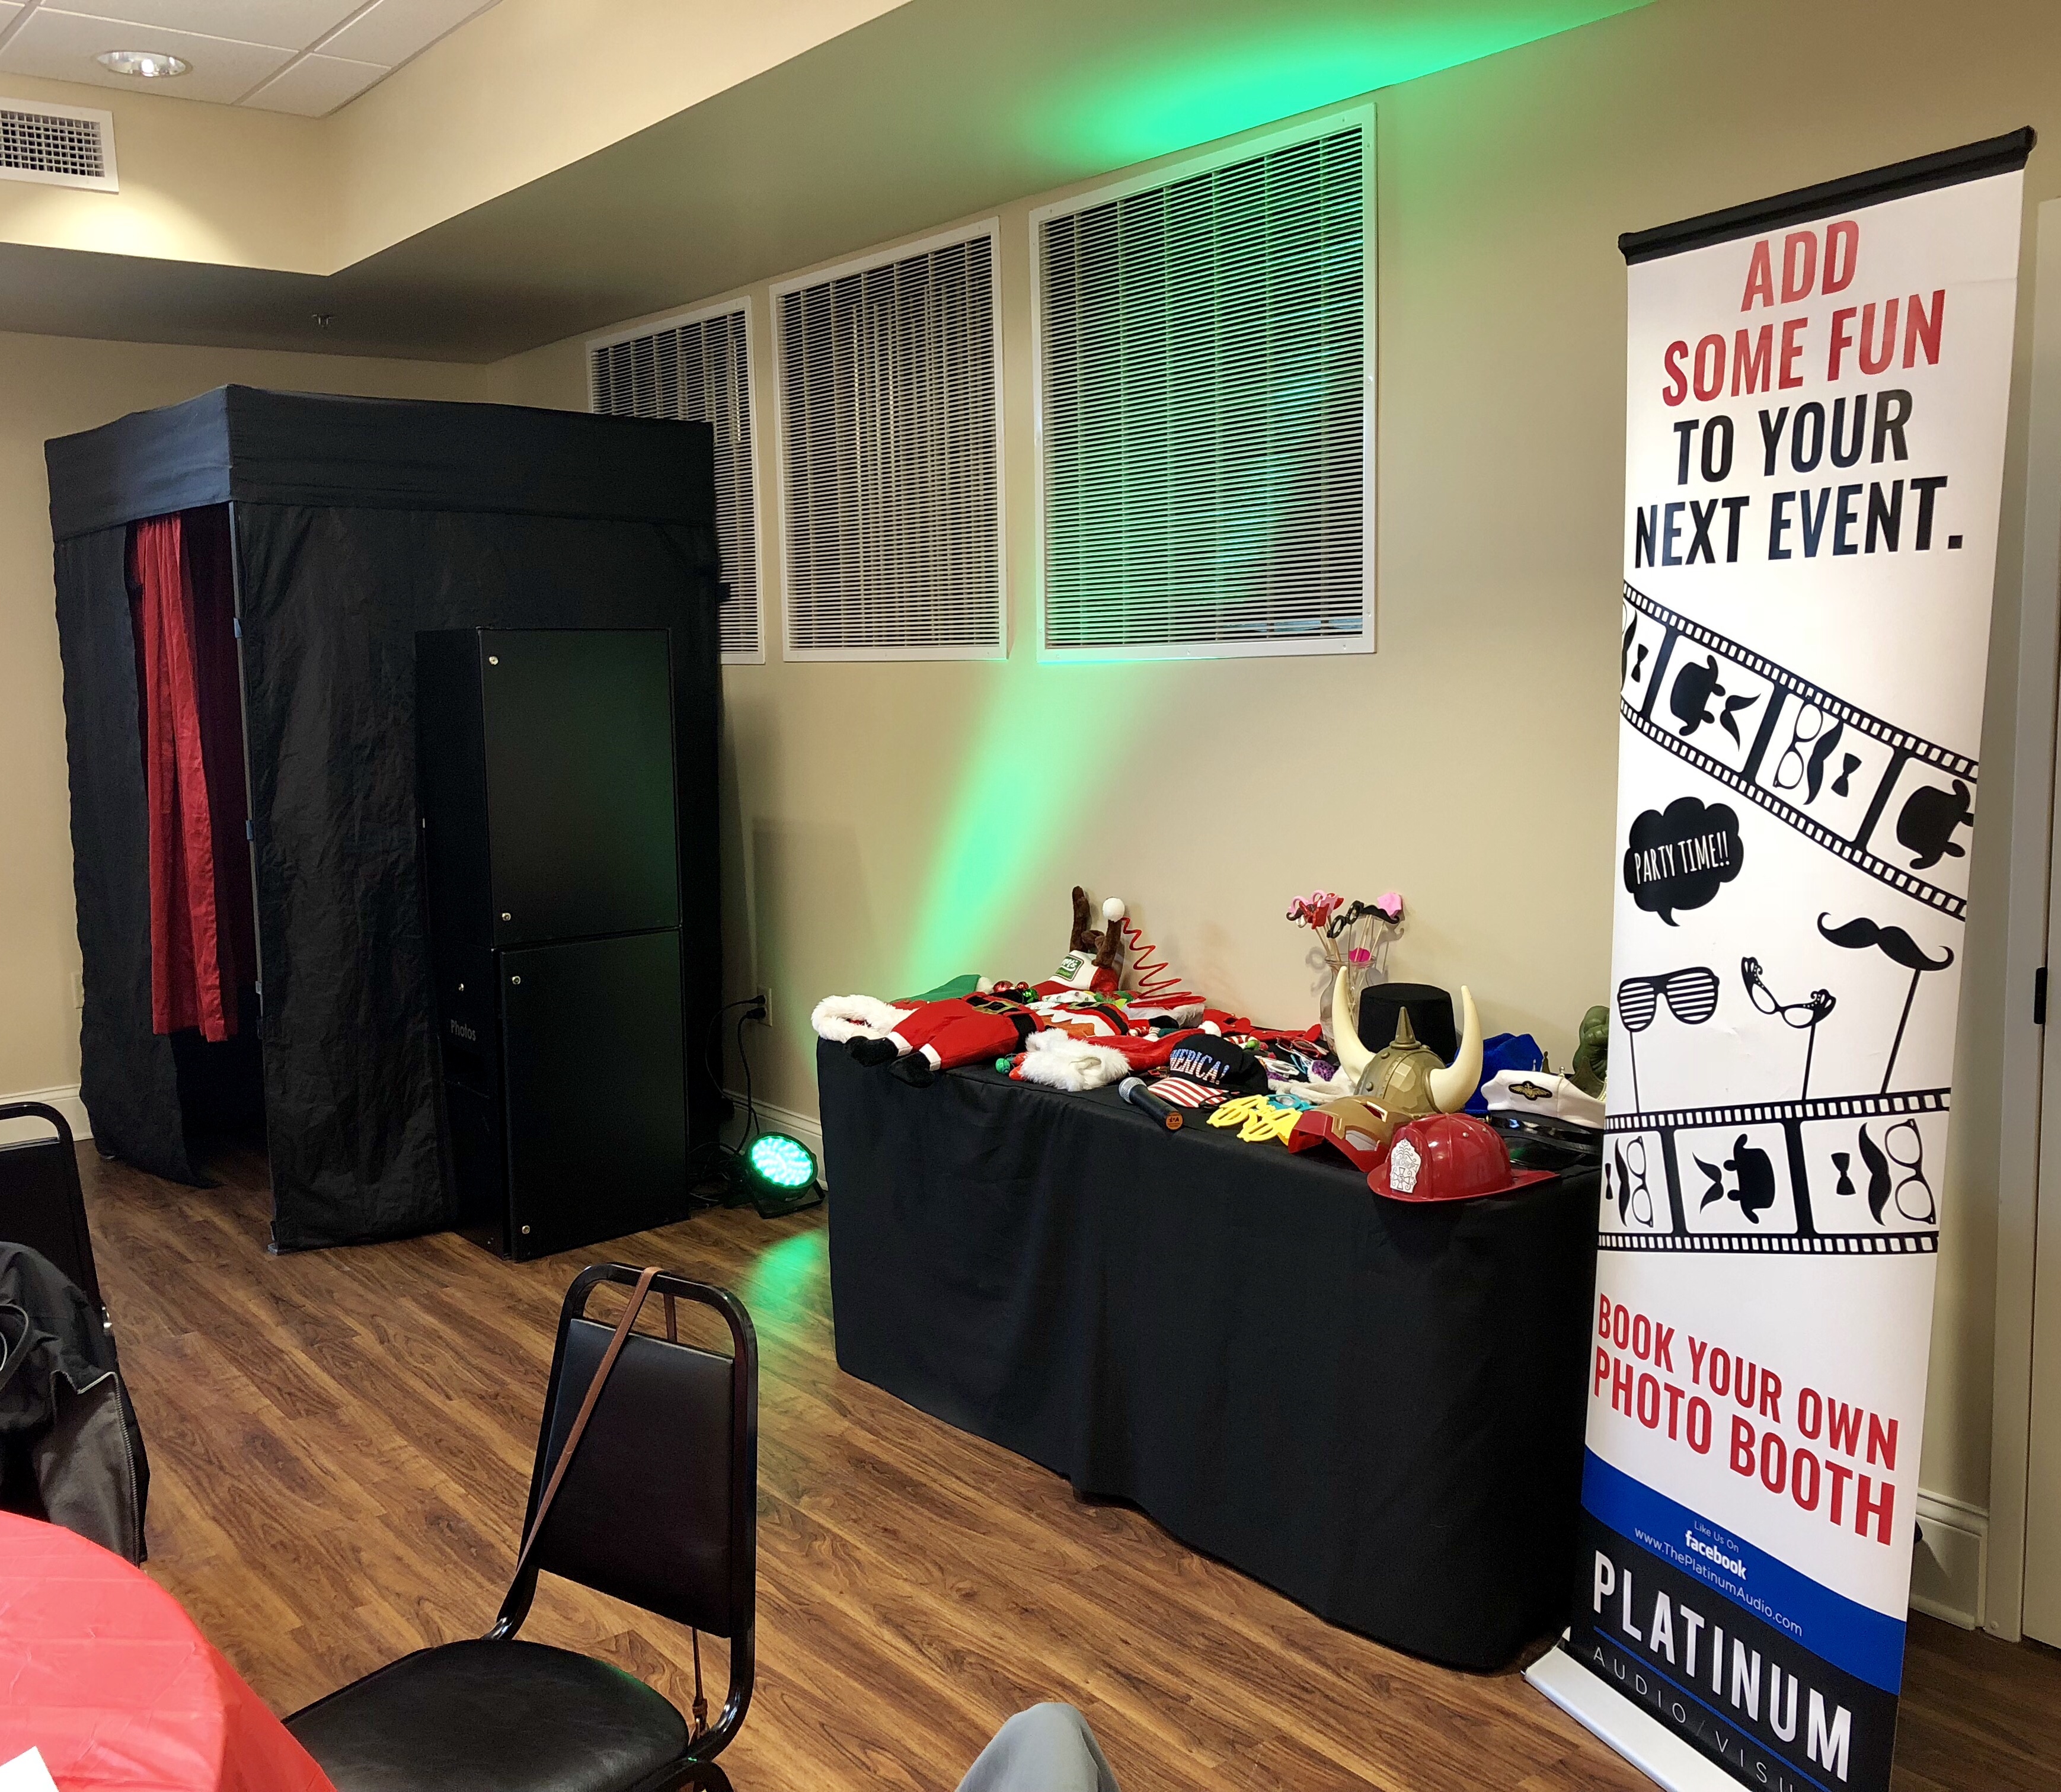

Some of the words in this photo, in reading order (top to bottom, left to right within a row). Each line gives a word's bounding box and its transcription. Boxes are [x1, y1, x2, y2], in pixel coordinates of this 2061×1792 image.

[1741, 220, 1859, 311] ADD
[1662, 318, 1808, 407] SOME
[1827, 290, 1945, 382] FUN
[1673, 415, 1734, 485] TO
[1758, 389, 1913, 476] YOUR
[1635, 496, 1750, 568] NEXT
[1768, 476, 1963, 560] EVENT.
[1634, 844, 1675, 884] PARTY
[1677, 831, 1730, 873] TIME!!
[450, 1019, 476, 1041] Photos
[1599, 1292, 1675, 1374] BOOK
[1688, 1336, 1781, 1423] YOUR
[1798, 1387, 1899, 1470] OWN
[1595, 1346, 1711, 1454] PHOTO
[1730, 1414, 1896, 1547] BOOTH
[1634, 1528, 1803, 1637] www.ThePlatinumAudio.com
[1685, 1530, 1747, 1580] facebook
[1694, 1521, 1711, 1537] Like
[1714, 1533, 1724, 1545] Us
[1726, 1540, 1740, 1553] On
[1595, 1550, 1852, 1783] PLATINUM
